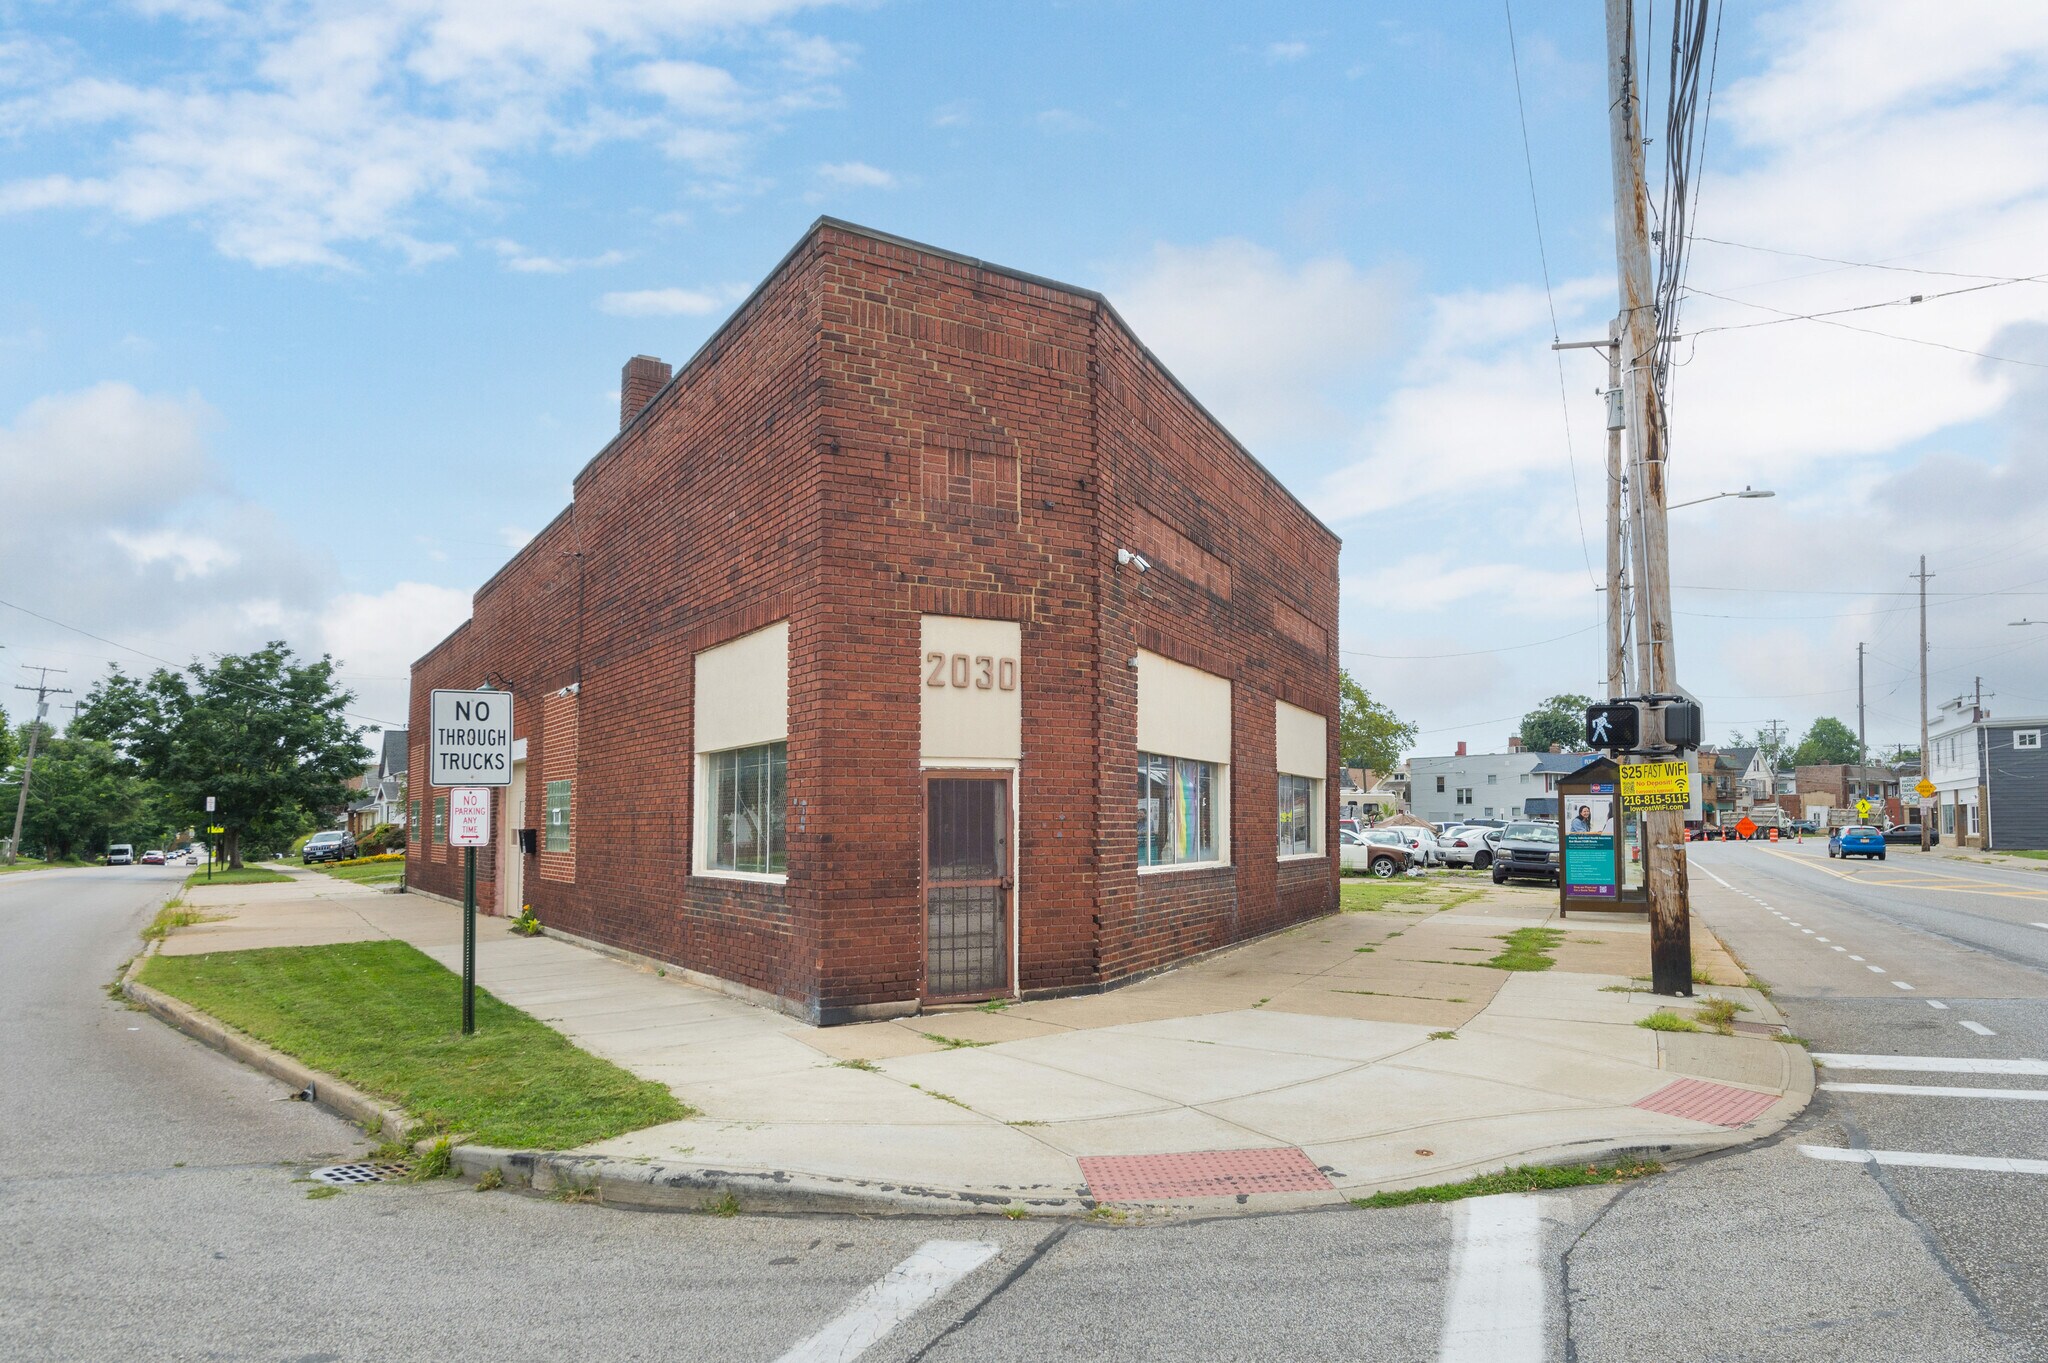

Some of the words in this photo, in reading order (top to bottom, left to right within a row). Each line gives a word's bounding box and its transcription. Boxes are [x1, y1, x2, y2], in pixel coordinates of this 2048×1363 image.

[927, 652, 1016, 690] 2030
[456, 701, 490, 721] NO
[438, 728, 506, 746] THROUGH
[440, 753, 505, 770] TRUCKS
[1621, 766, 1642, 779] $25
[1644, 764, 1662, 778] FAST
[1665, 762, 1687, 776] WiFi
[463, 796, 477, 805] NO
[1624, 794, 1688, 805] 216-815-5115
[1630, 804, 1683, 812] lowcostWiFi.com
